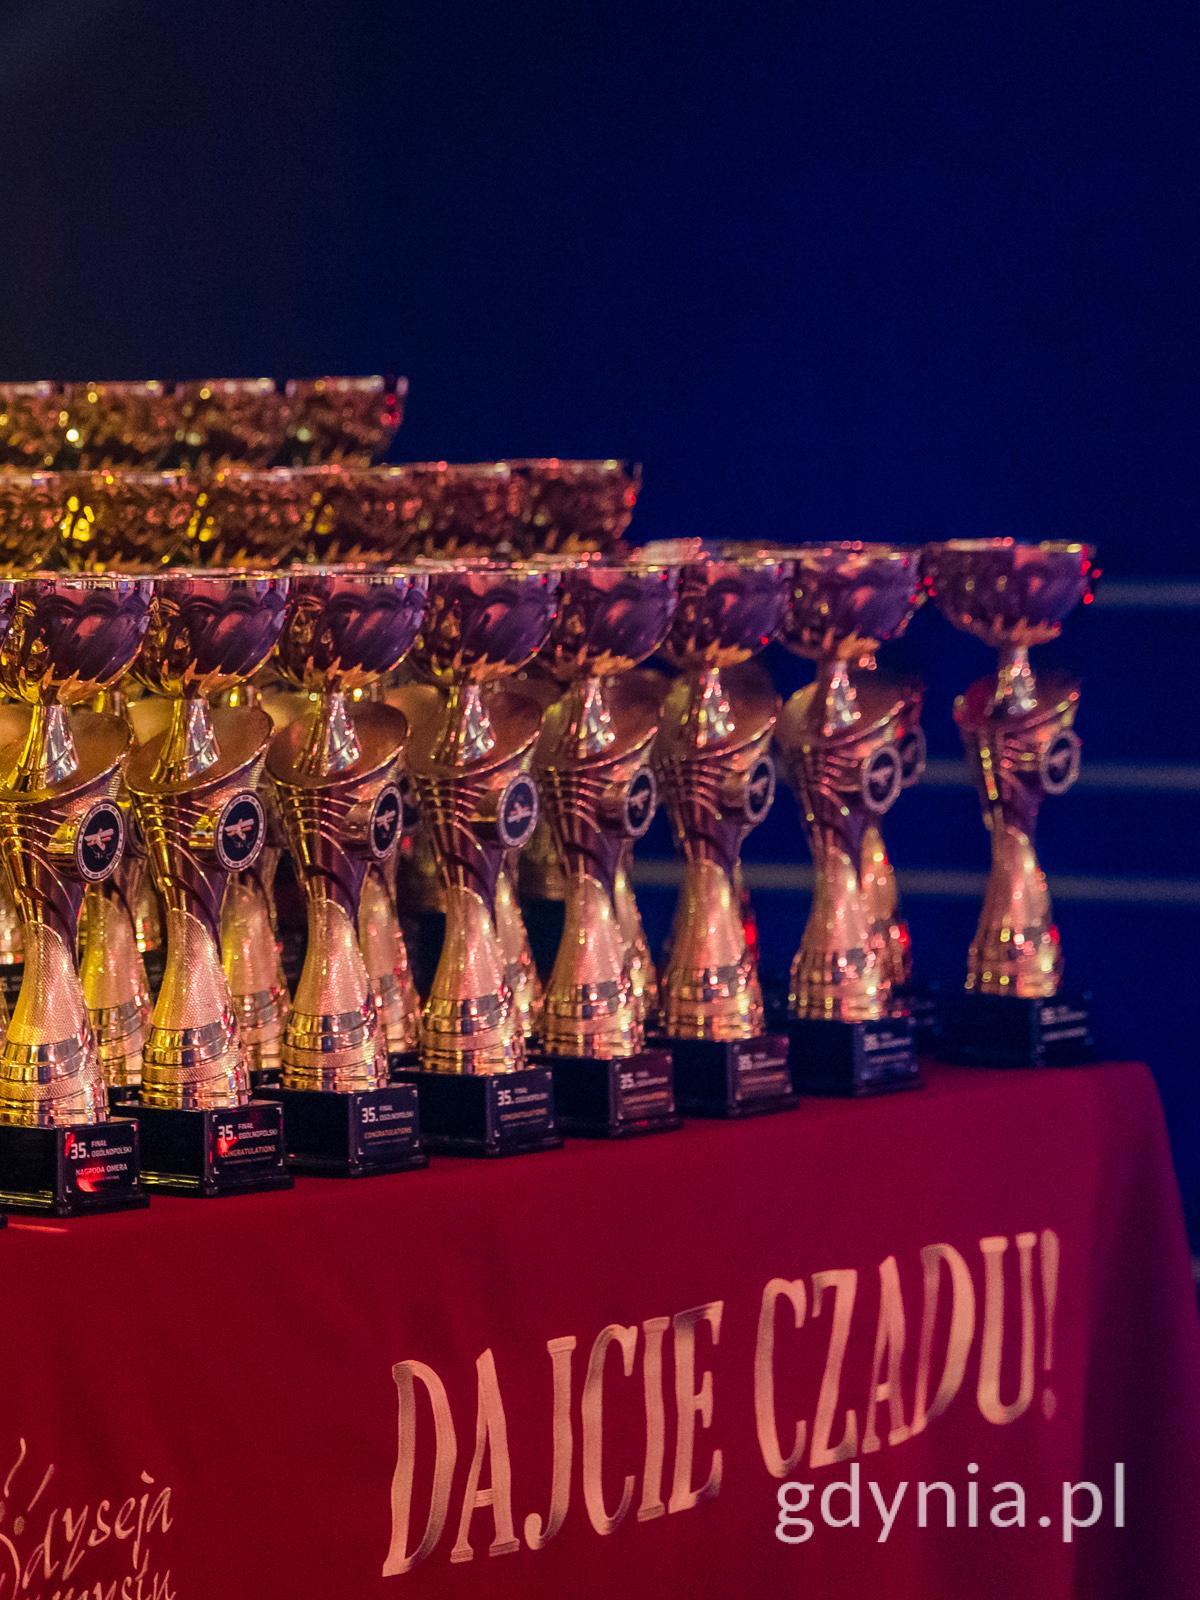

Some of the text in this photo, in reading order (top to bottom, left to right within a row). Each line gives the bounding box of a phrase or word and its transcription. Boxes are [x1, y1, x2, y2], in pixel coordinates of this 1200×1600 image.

[361, 1106, 379, 1123] 35.
[218, 1124, 238, 1141] 35.
[70, 1142, 91, 1160] 35.
[106, 1163, 128, 1173] OMERA
[382, 1228, 1060, 1578] DAJCIE CZADU!
